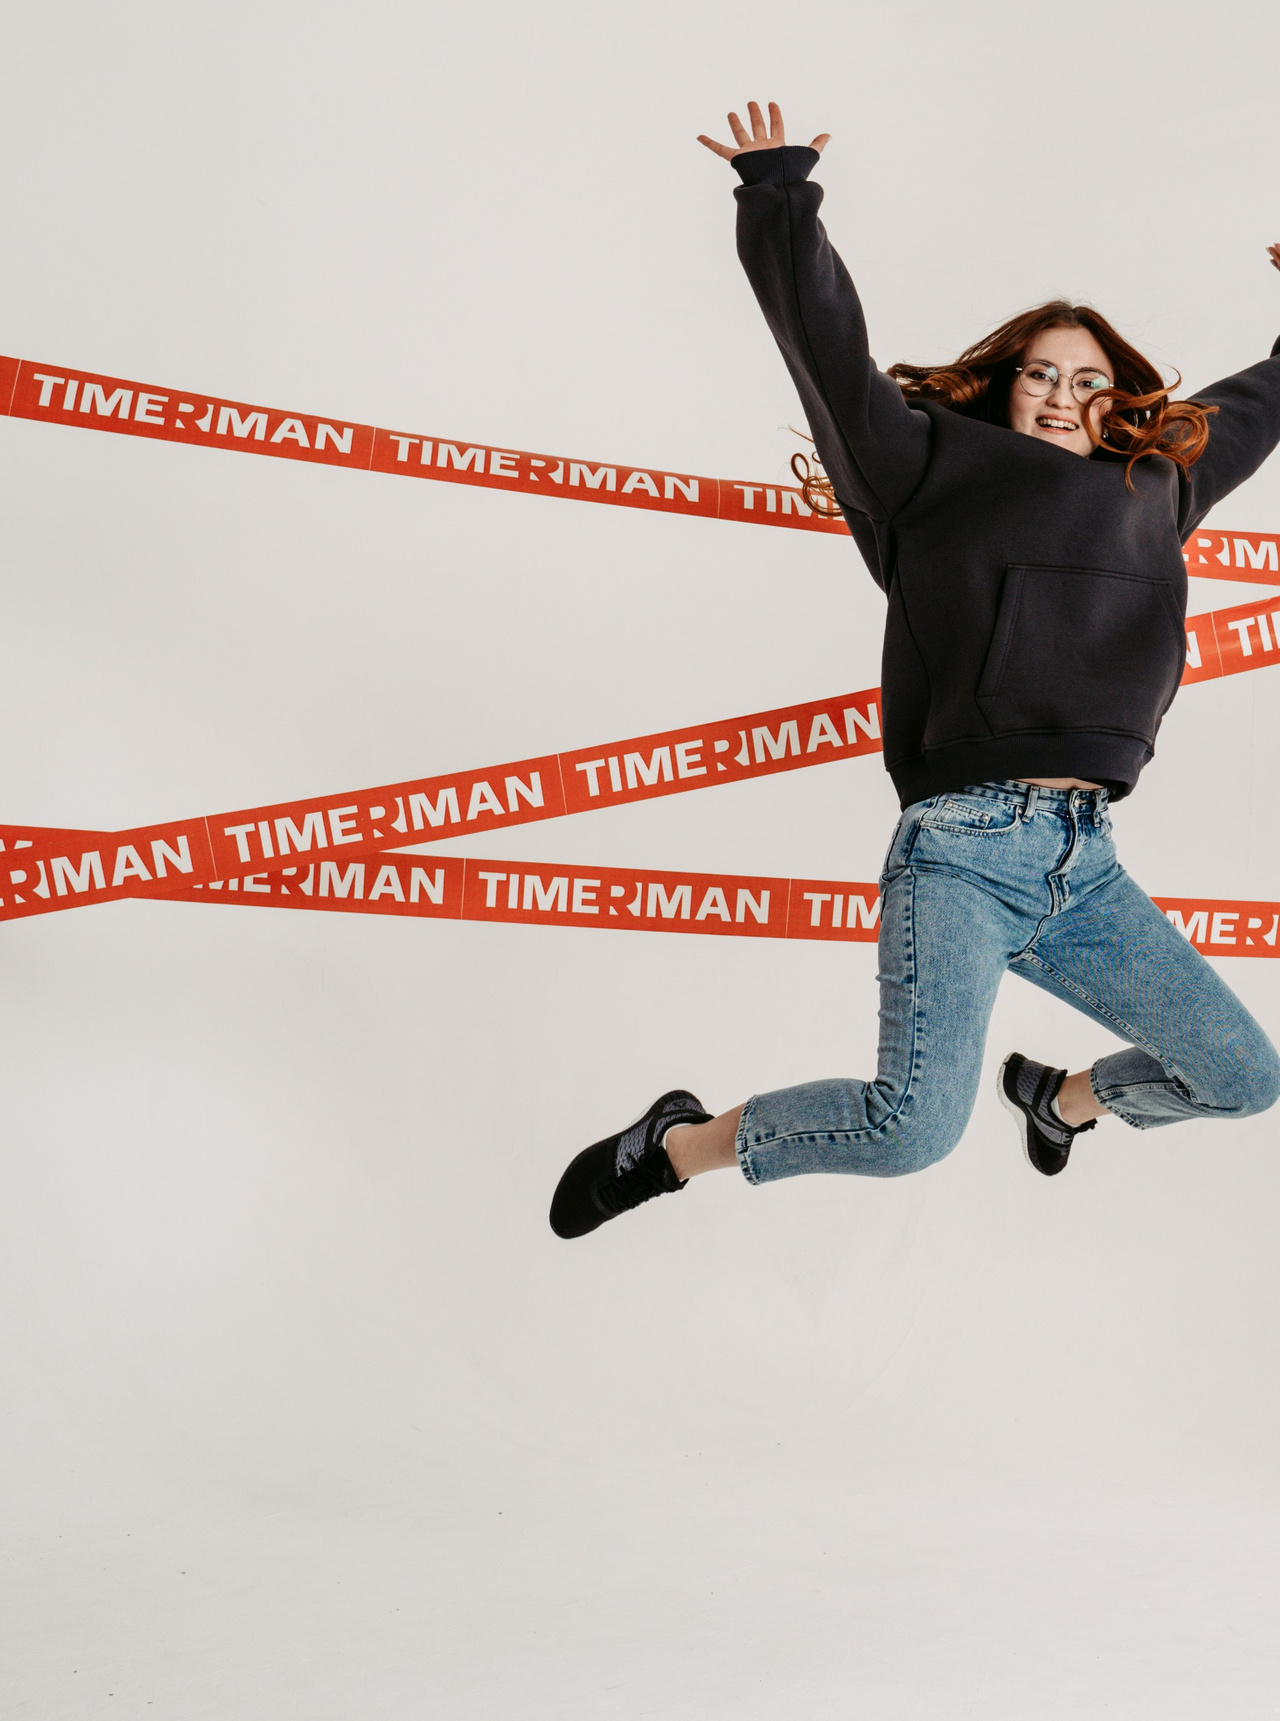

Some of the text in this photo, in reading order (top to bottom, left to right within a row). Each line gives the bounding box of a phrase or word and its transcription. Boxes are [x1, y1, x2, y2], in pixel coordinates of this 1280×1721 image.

[33, 373, 354, 455] TIMERMAN
[389, 434, 700, 503] TIMERMAN
[0, 834, 194, 907] RMAN
[224, 771, 545, 864] TIMERMAN
[575, 702, 881, 797] TIMERMAN
[478, 871, 770, 925] TIMERMAN
